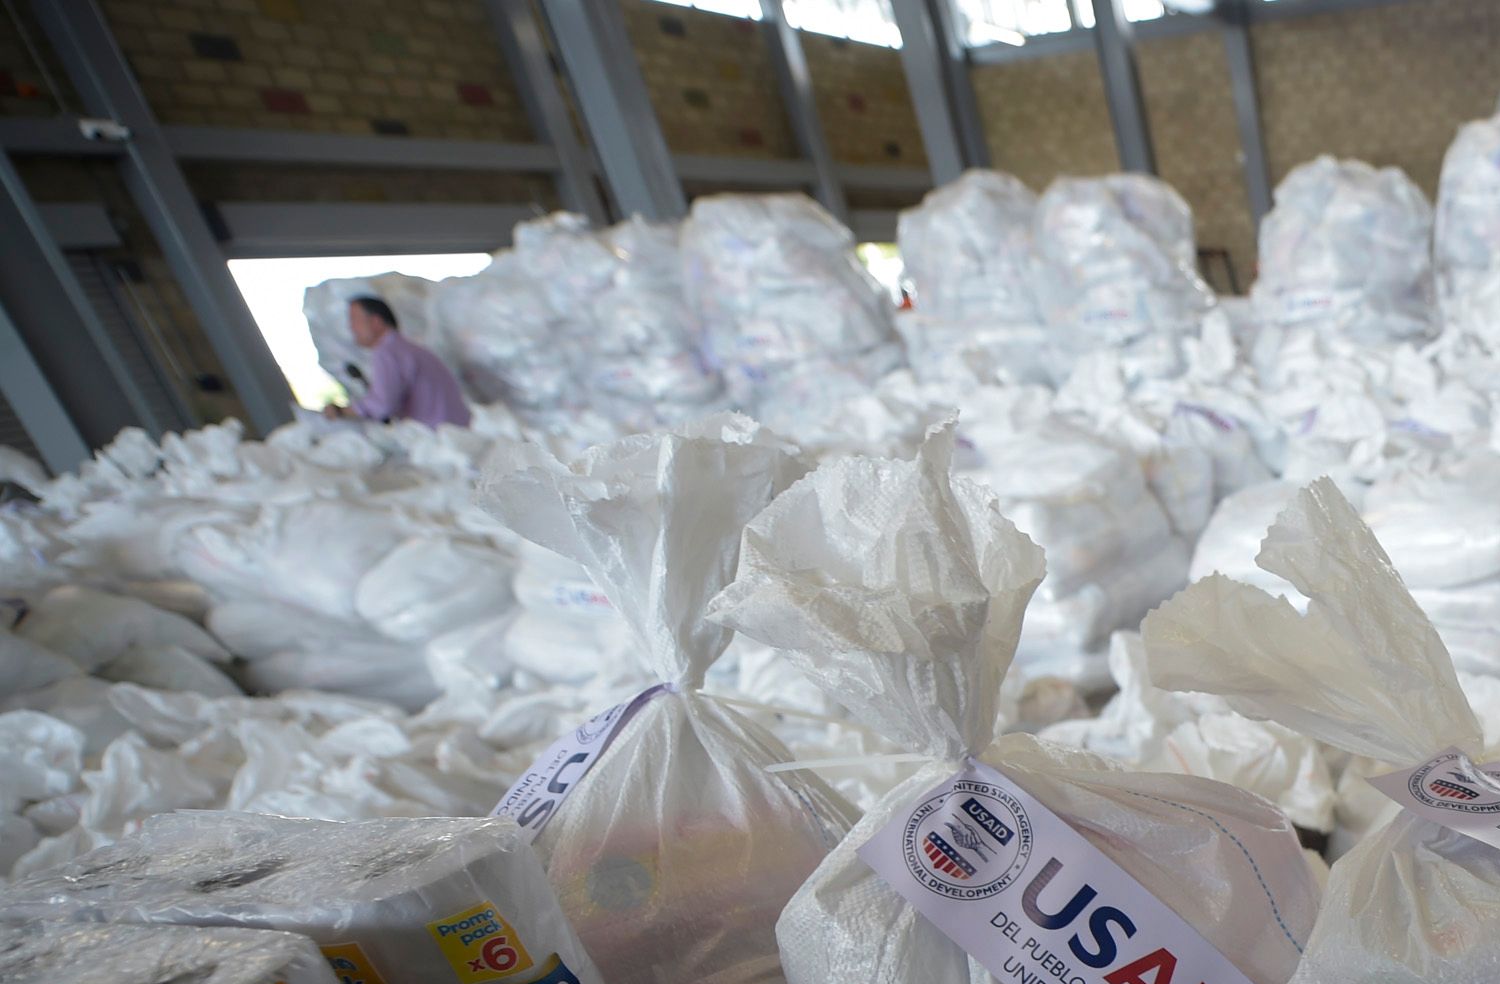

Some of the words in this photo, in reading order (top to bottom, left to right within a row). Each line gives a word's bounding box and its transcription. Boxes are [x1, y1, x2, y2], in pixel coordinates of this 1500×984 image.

[968, 803, 1009, 839] USAID
[992, 788, 1021, 815] STATES
[1016, 814, 1030, 858] AGENCY
[928, 873, 1012, 898] DEVELOPMENT
[436, 908, 495, 937] Promo
[459, 921, 502, 947] pack
[990, 911, 1019, 944] DEL
[467, 935, 518, 972] x6
